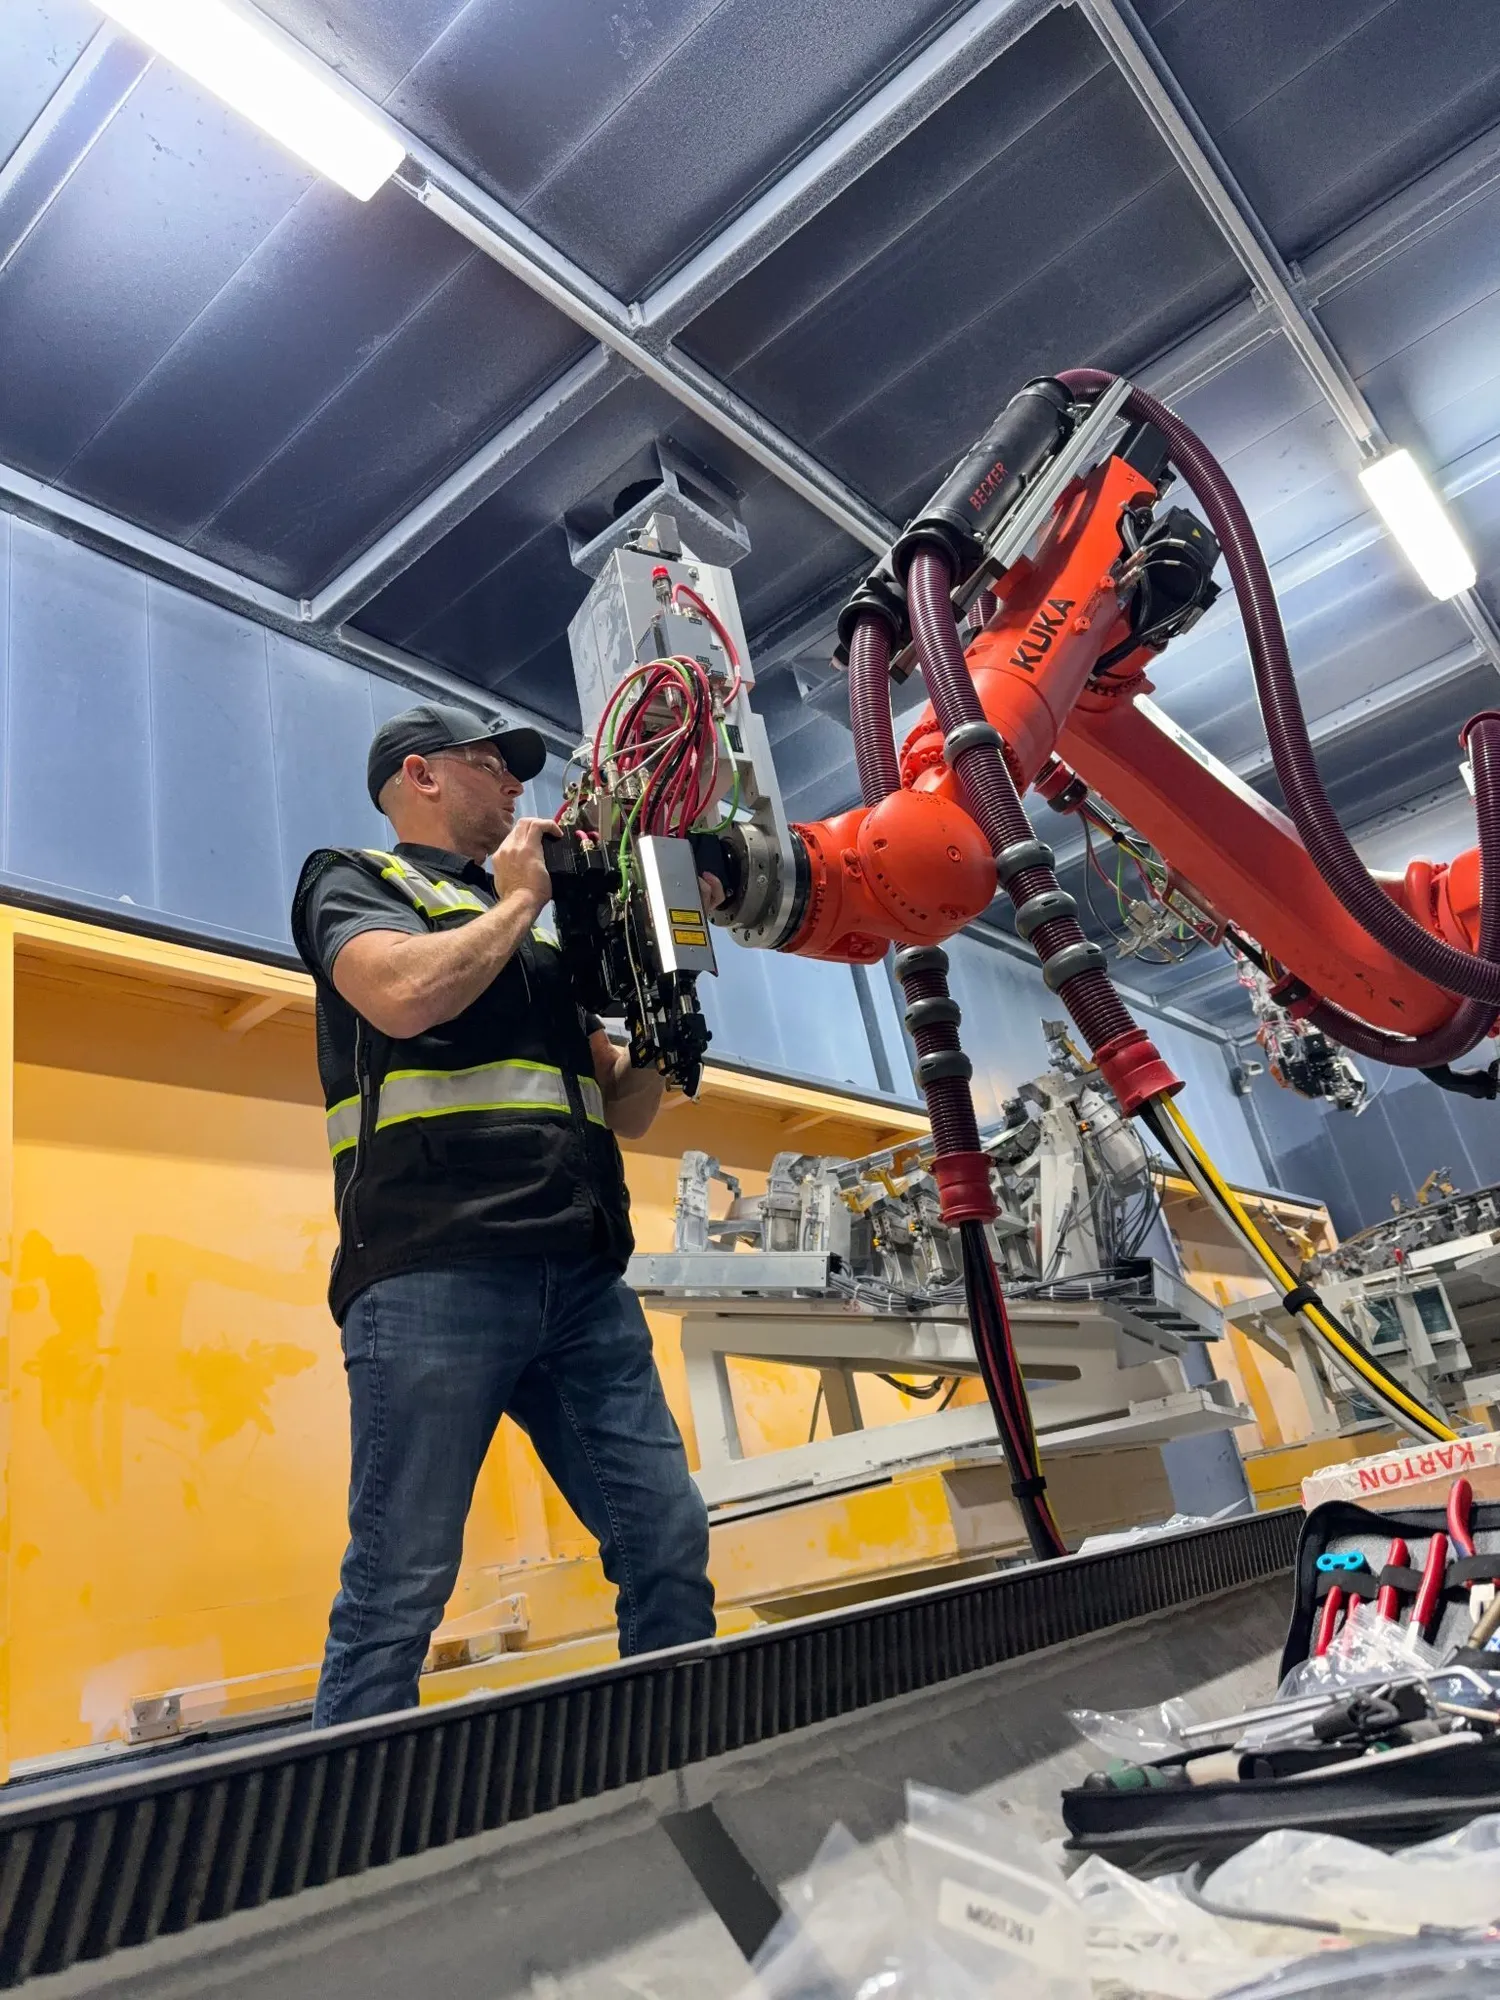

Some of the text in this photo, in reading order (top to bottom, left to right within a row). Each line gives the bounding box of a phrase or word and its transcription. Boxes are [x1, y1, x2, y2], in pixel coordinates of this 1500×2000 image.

[969, 461, 1009, 512] BECKER
[1009, 599, 1076, 674] KUKA
[1358, 1440, 1476, 1490] KARTON
